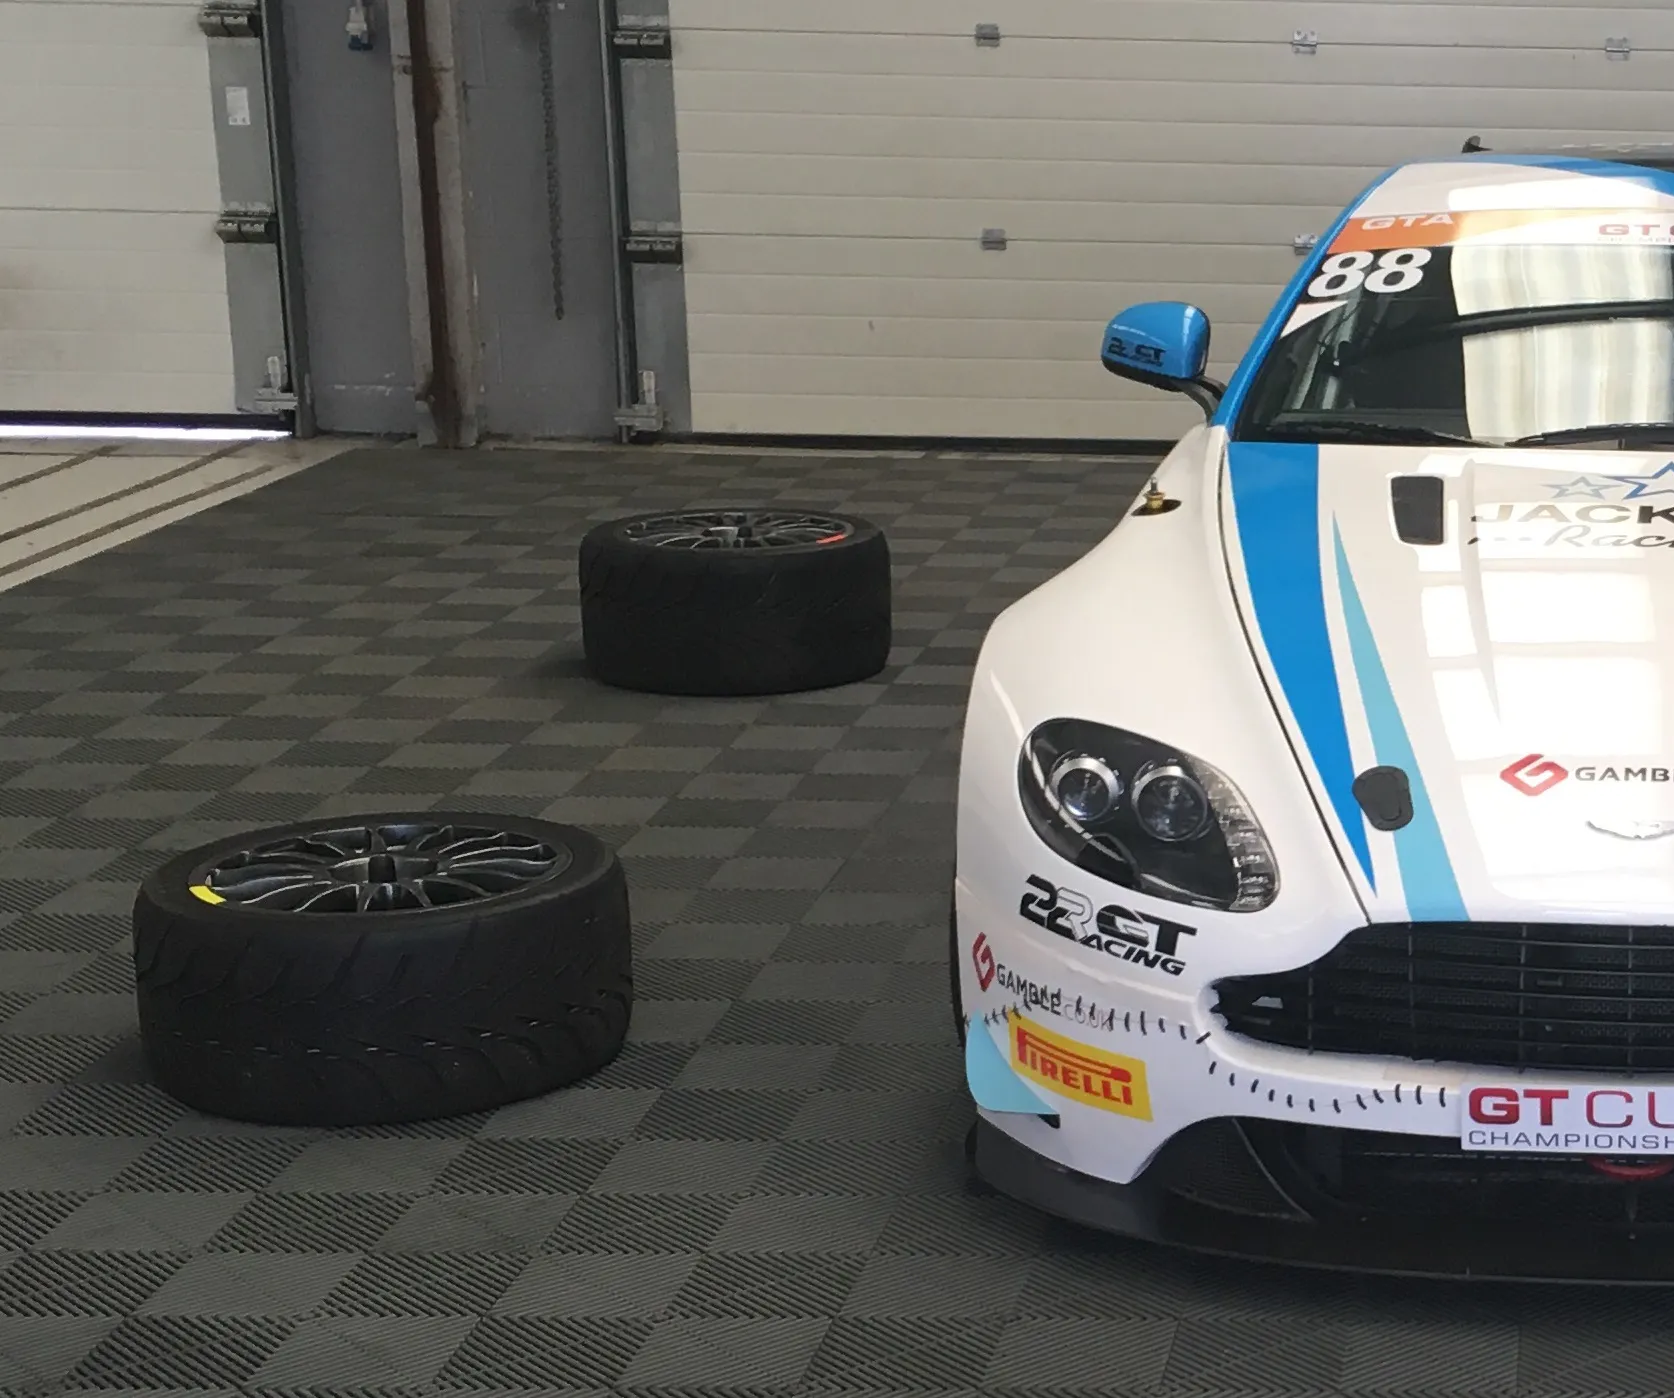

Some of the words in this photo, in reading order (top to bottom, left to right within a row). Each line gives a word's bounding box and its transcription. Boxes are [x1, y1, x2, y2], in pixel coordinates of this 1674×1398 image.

[1362, 214, 1454, 231] GTA
[1307, 248, 1432, 298] 88
[1016, 1026, 1133, 1106] PIRELLI
[1468, 1087, 1569, 1126] GT
